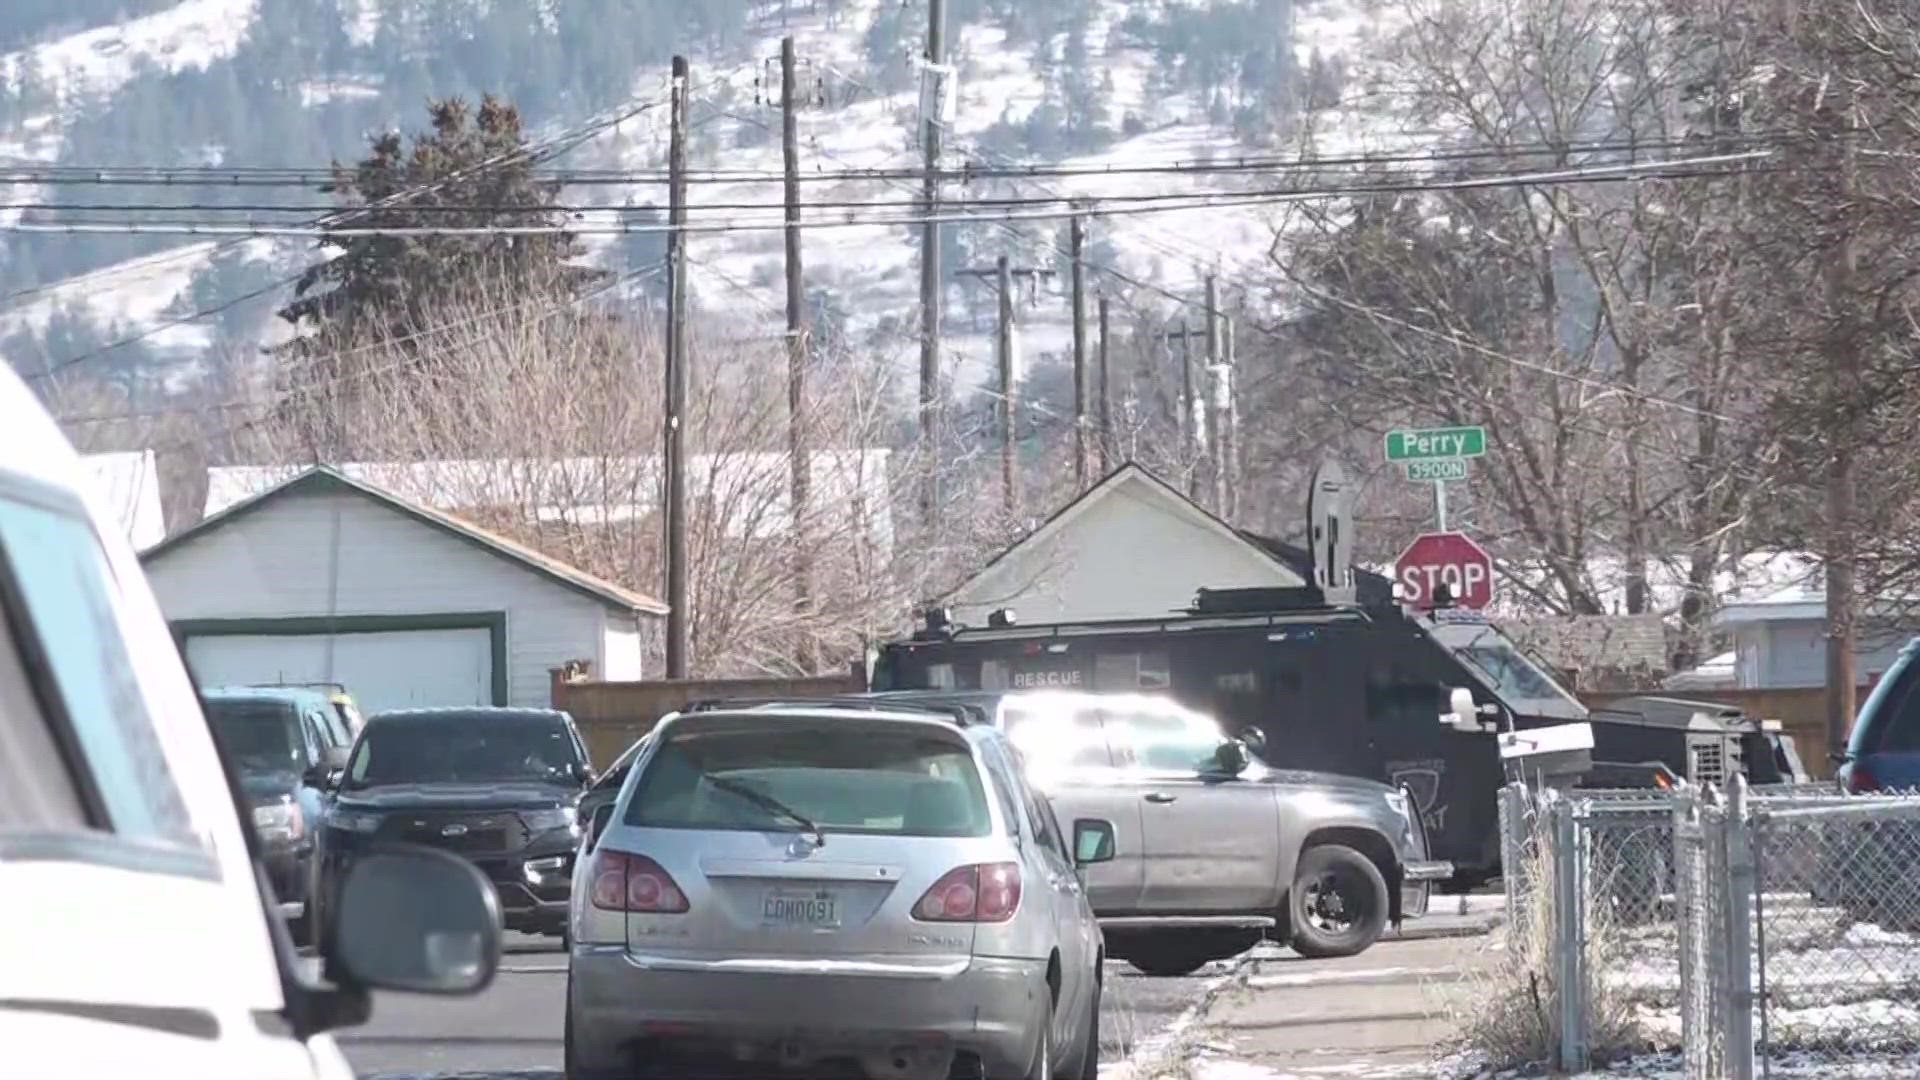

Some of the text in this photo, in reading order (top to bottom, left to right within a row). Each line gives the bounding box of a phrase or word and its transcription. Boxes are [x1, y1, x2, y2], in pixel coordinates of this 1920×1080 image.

[1402, 432, 1466, 457] Perry
[1411, 462, 1463, 478] 3900N
[1403, 563, 1484, 601] STOP
[1014, 670, 1081, 688] RESCUE
